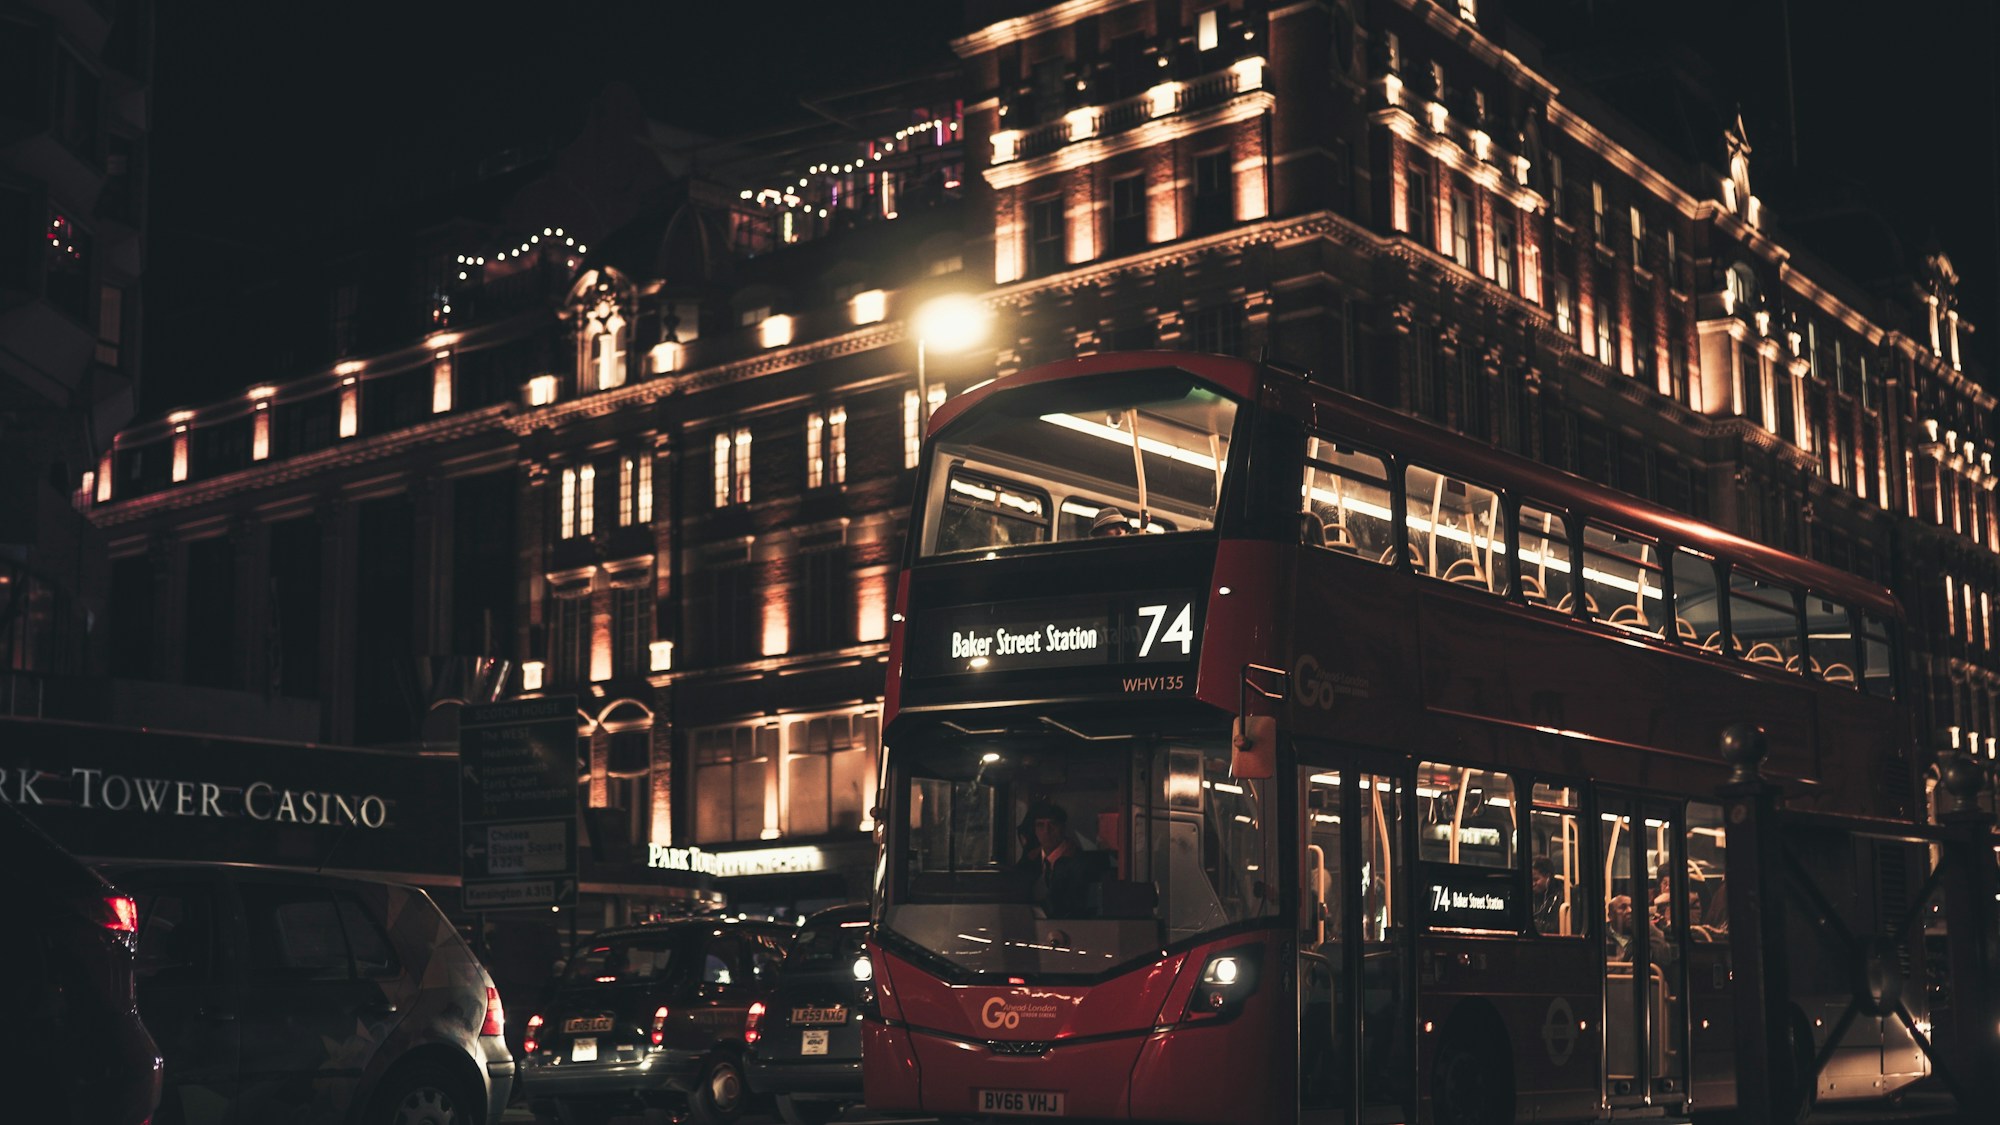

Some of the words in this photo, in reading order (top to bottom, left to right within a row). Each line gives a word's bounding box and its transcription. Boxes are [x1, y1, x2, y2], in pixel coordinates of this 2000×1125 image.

[951, 631, 992, 658] Baker
[996, 627, 1041, 656] Street
[1046, 624, 1097, 654] Station
[1138, 602, 1194, 658] 74
[1122, 675, 1184, 692] WHV135
[1294, 654, 1334, 710] Go
[475, 705, 519, 721] SCOTCH
[522, 703, 561, 716] HOUSE
[501, 727, 530, 739] WEST
[72, 767, 226, 818] TOWER
[245, 781, 387, 829] CASINO
[490, 829, 530, 841] Chelsea
[648, 842, 689, 870] PARK
[1432, 885, 1451, 912] 74
[1469, 892, 1486, 909] Street
[1485, 893, 1505, 911] Station
[795, 1010, 822, 1022] LR59
[981, 996, 1020, 1030] Go
[984, 1092, 1023, 1110] BV66
[1028, 1094, 1057, 1112] VHJ
